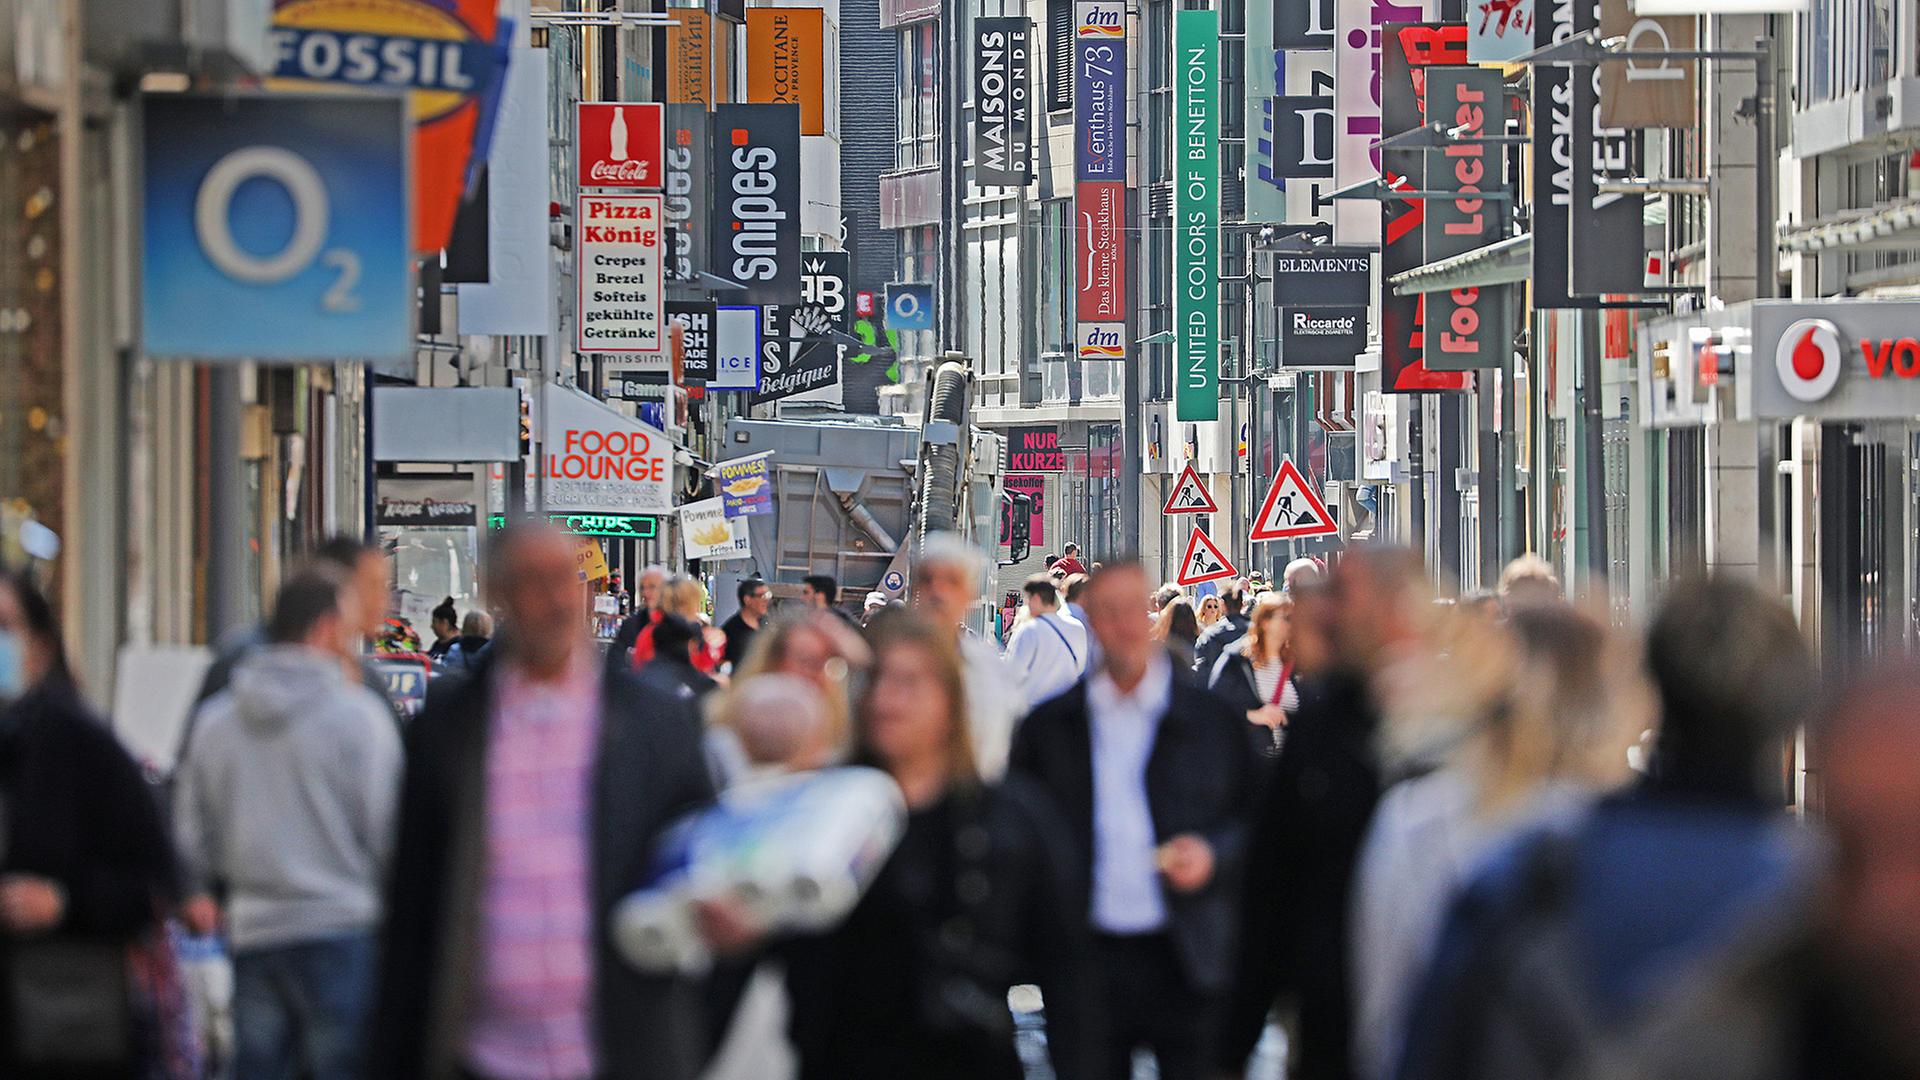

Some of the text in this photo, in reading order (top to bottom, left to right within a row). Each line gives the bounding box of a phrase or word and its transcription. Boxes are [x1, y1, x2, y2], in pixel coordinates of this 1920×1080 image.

[1086, 6, 1118, 26] dm
[270, 31, 474, 89] FOSSIL
[791, 36, 799, 91] PROVENCE
[981, 31, 1005, 172] MAISONS
[1012, 31, 1026, 172] DU MONDE
[1084, 46, 1114, 173] Eventhaus 73
[1444, 83, 1484, 235] Locker
[1188, 170, 1206, 201] OF
[589, 202, 652, 220] Pizza
[732, 147, 787, 280] snipes
[194, 146, 362, 312] O2
[584, 226, 656, 248] König
[594, 255, 646, 268] Crepes
[1098, 187, 1110, 315] Das kleine Steakhaus
[1188, 211, 1206, 301] COLORS
[596, 273, 644, 284] Brezel
[1278, 258, 1369, 272] ELEMENTS
[593, 291, 647, 302] Softeis
[895, 293, 925, 322] O2
[586, 309, 654, 323] gekühlte
[1293, 313, 1355, 328] Riccardo
[584, 327, 656, 339] Getränke
[1087, 328, 1119, 348] dm
[1188, 310, 1206, 389] UNITED
[759, 364, 833, 396] Belgique
[565, 430, 650, 456] FOOD
[1023, 432, 1057, 449] NUR
[550, 454, 664, 481] LOUNGE
[1011, 453, 1065, 470] KURZE
